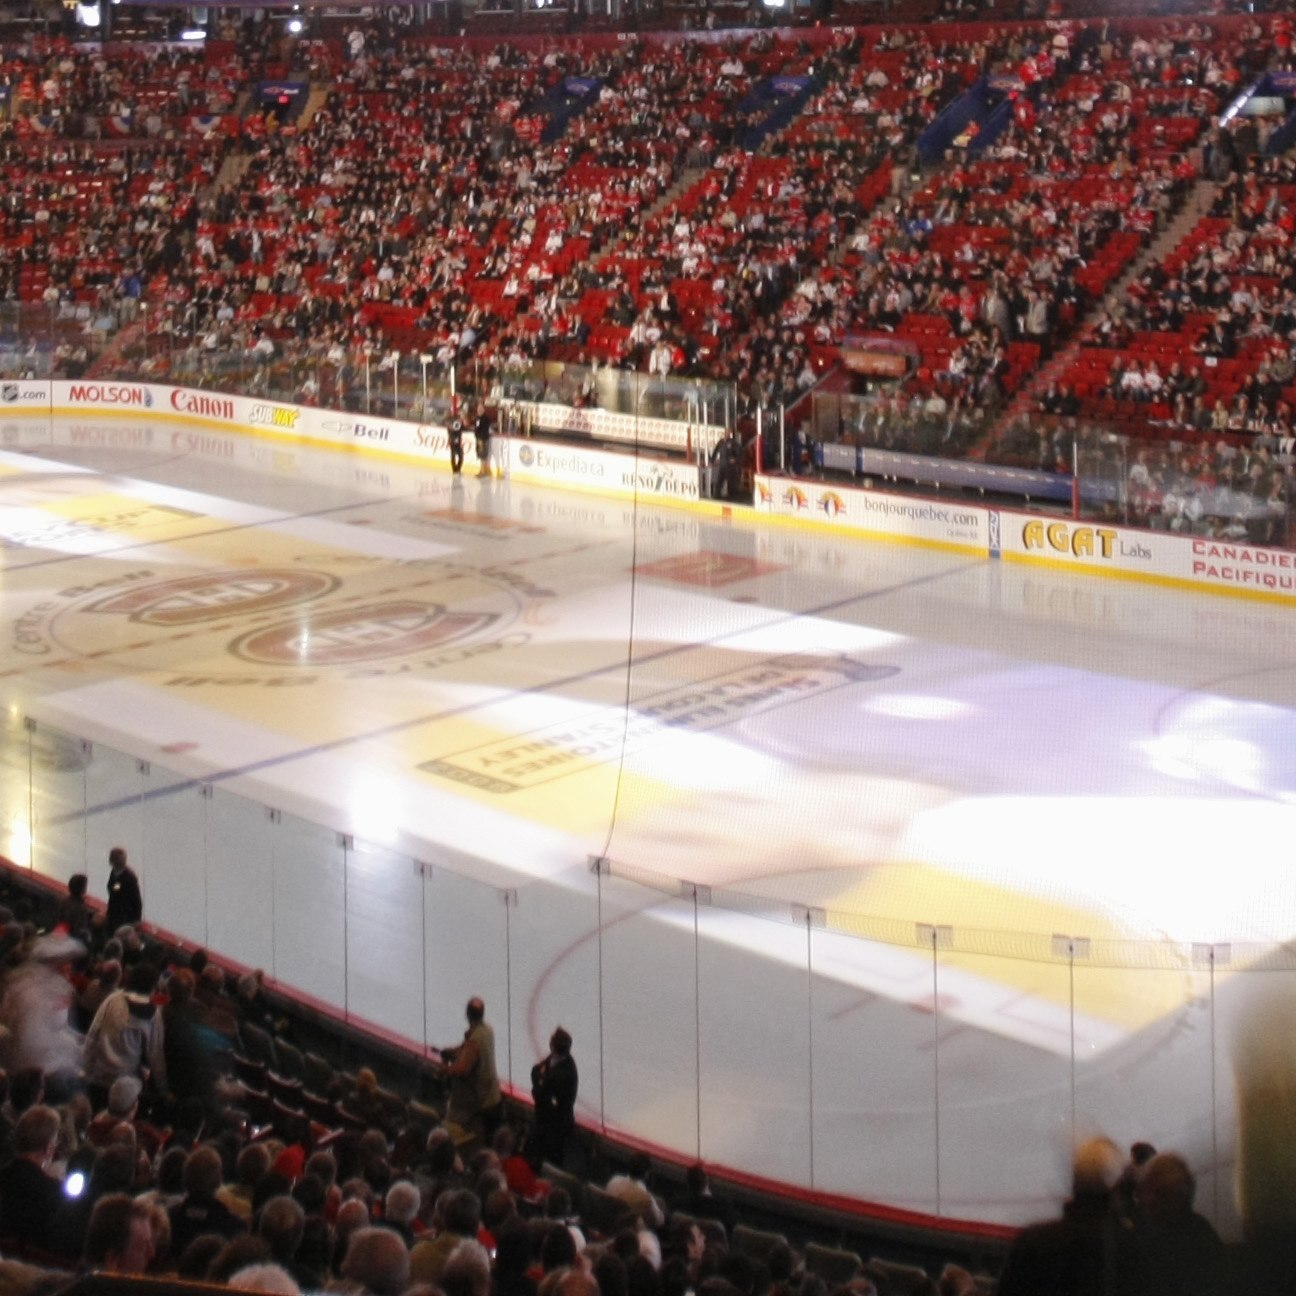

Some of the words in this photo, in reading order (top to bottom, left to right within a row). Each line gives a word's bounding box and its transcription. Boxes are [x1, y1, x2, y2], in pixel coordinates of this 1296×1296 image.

[19, 390, 46, 401] .com
[68, 385, 142, 405] MOLSON
[170, 389, 234, 419] Canon
[249, 403, 301, 429] SUBWAY
[353, 423, 390, 442] Bell
[864, 496, 979, 527] bonjourquebec.com
[1021, 519, 1119, 558] AGAT
[1119, 538, 1153, 559] Labs
